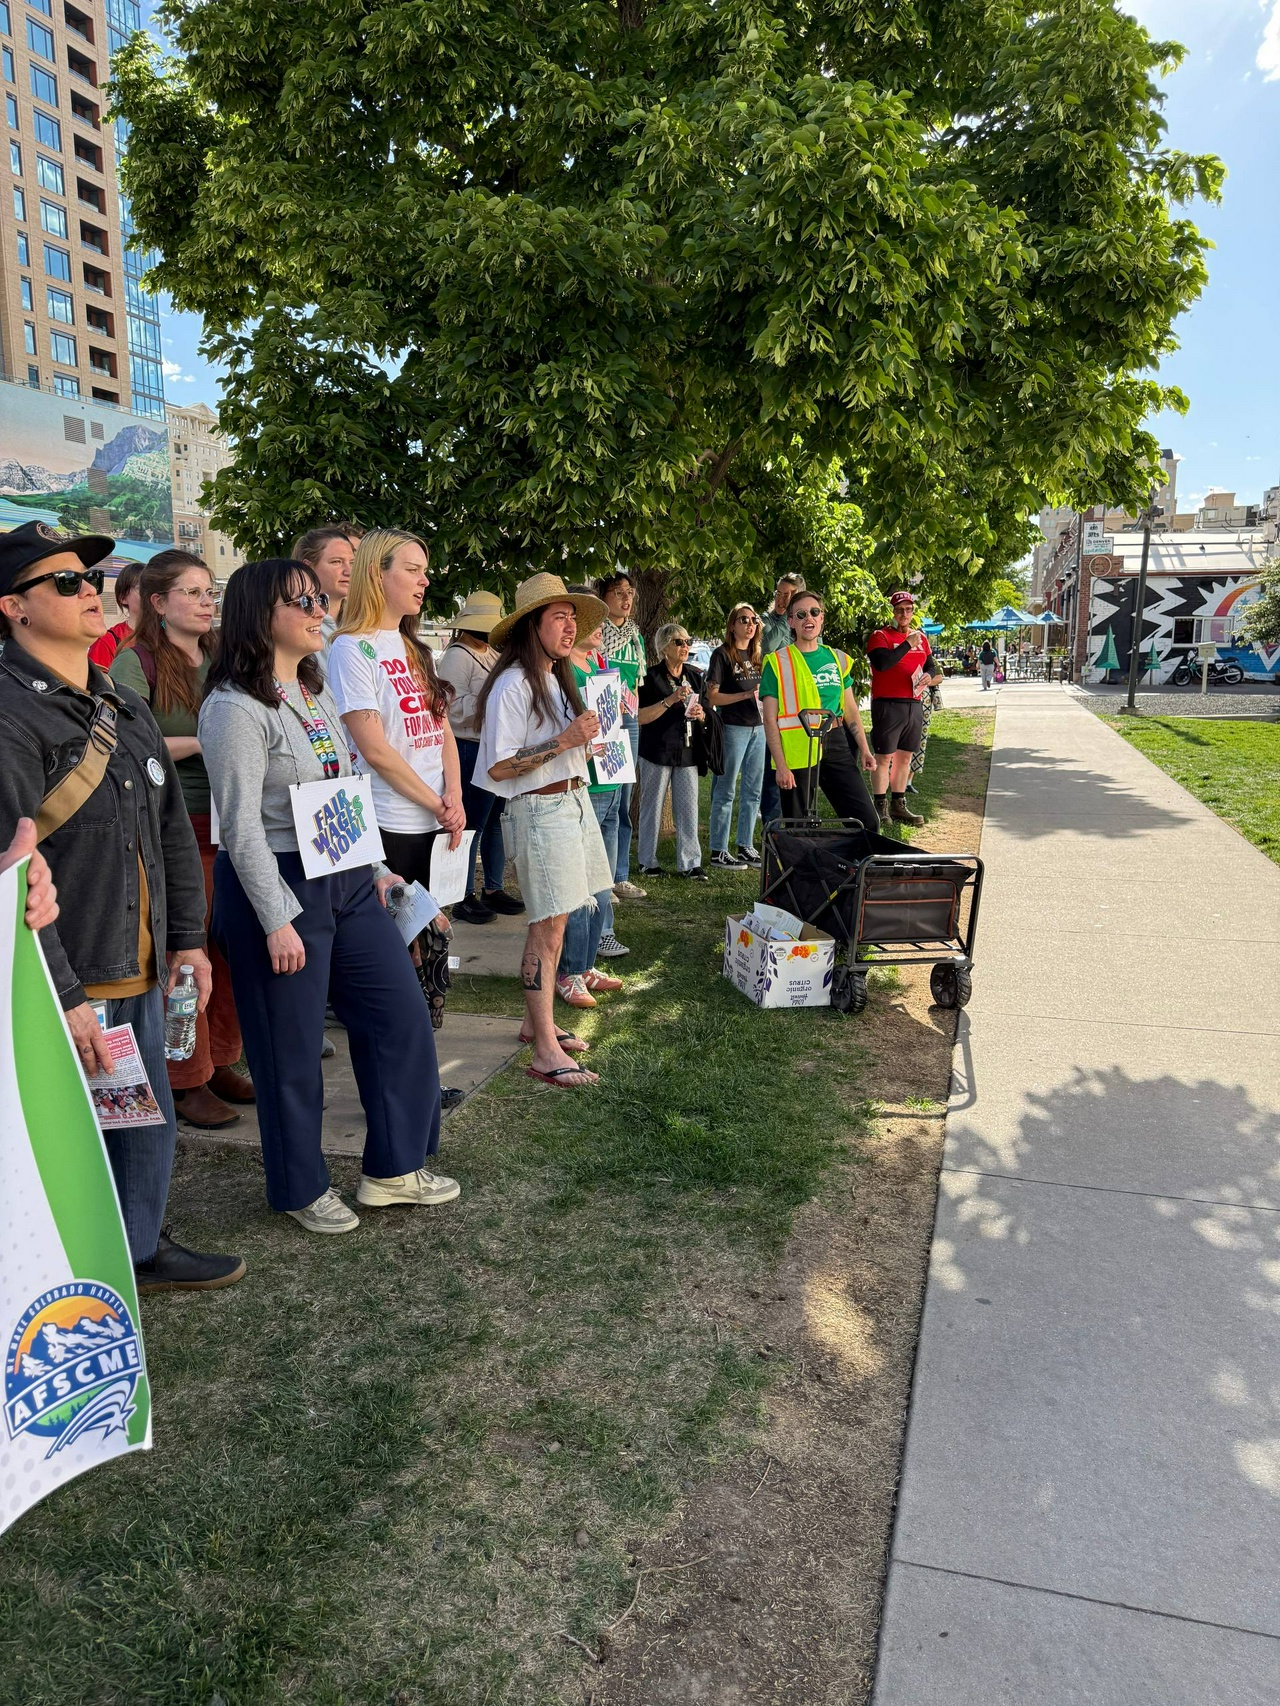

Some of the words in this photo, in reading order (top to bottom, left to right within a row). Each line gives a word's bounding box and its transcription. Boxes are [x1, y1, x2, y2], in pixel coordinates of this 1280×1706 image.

[596, 683, 613, 713] FAIR
[600, 702, 619, 739] NOW!
[306, 724, 328, 759] DENVER
[317, 723, 336, 759] DENVER
[600, 740, 625, 772] WAGES
[606, 751, 628, 780] NOW!
[310, 794, 364, 856] WAGES
[312, 788, 350, 834] FAIR
[325, 813, 368, 868] NOW!
[785, 985, 812, 994] organic
[10, 1318, 28, 1351] MAKE
[28, 1284, 83, 1317] COLORADO
[89, 1285, 125, 1315] HAPPEN
[14, 1342, 139, 1428] AFSCME
